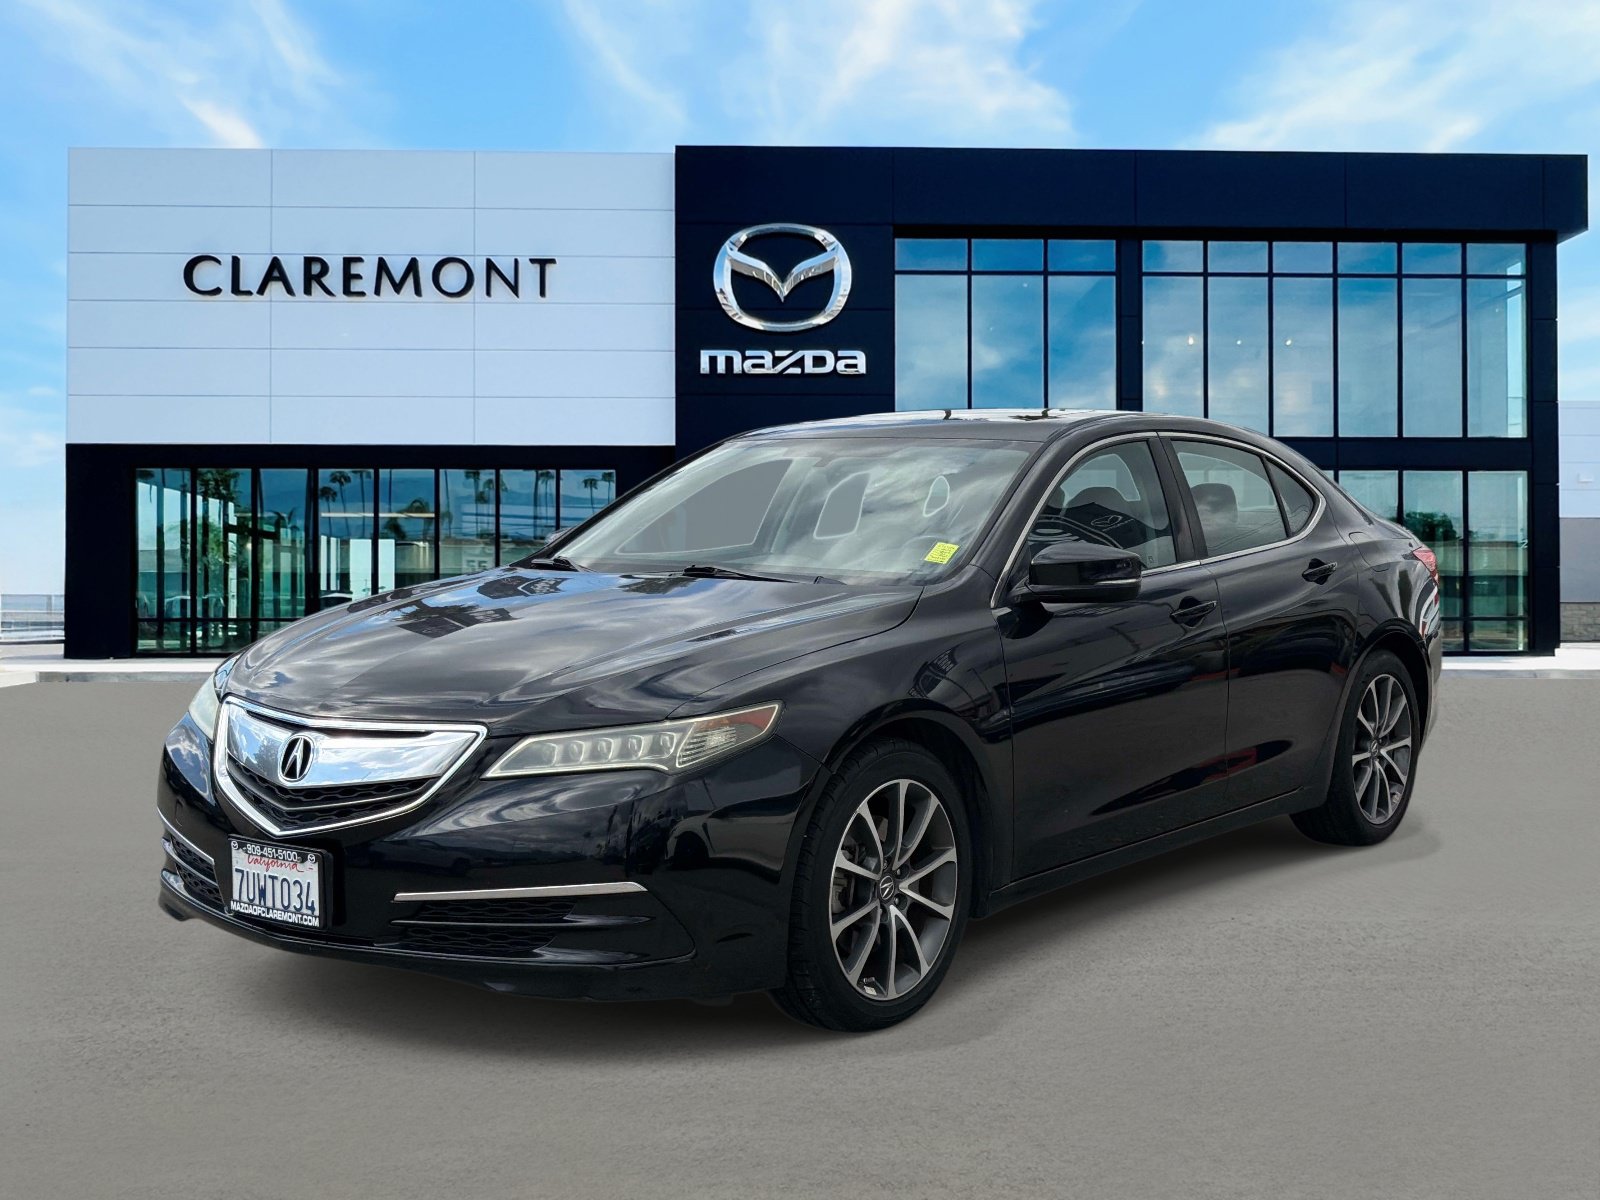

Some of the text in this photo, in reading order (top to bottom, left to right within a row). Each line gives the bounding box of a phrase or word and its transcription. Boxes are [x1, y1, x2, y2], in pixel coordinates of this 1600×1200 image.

[183, 254, 557, 298] CLAREMONT
[700, 349, 867, 375] mazda
[246, 843, 298, 862] 909-451-5100
[235, 867, 315, 915] 7UWT034
[230, 900, 319, 927] MAZDAOFCLAREMONT.COM
